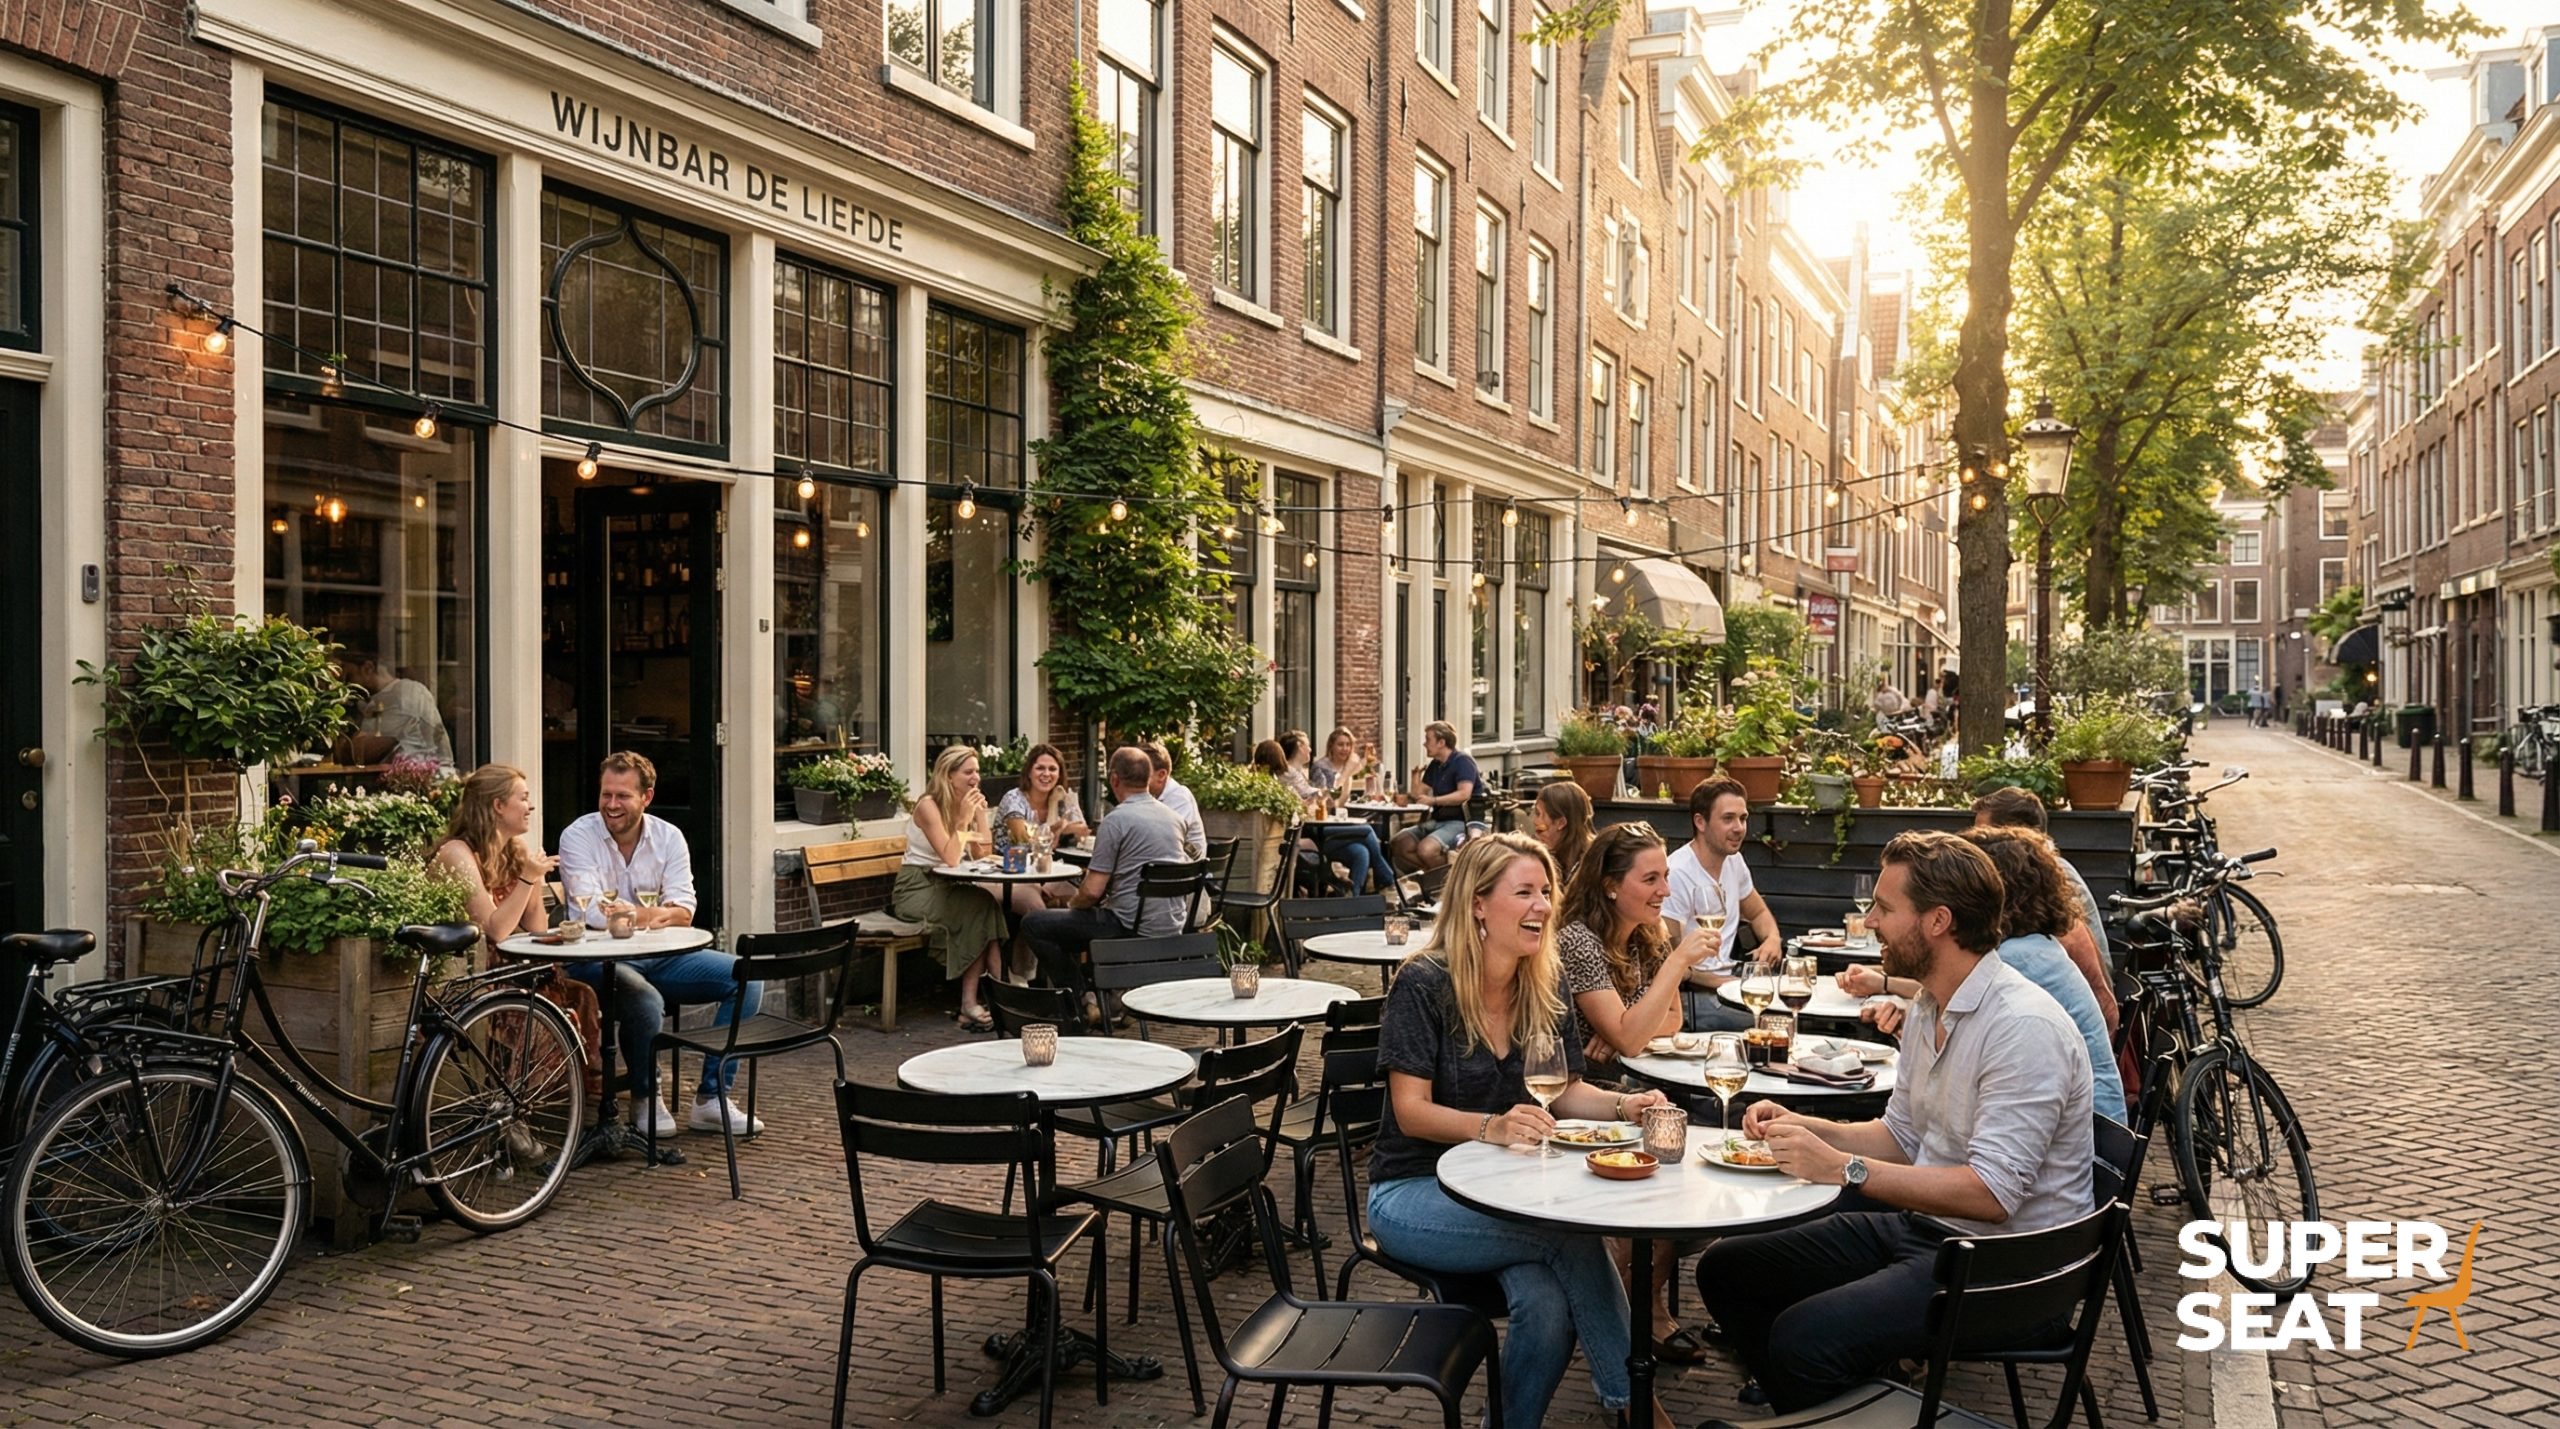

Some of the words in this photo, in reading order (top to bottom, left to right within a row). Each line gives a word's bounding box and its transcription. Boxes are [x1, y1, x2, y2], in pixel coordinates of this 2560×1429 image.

[550, 90, 731, 192] WIJNBAR
[745, 164, 789, 213] DE
[802, 185, 904, 253] LIEFDE
